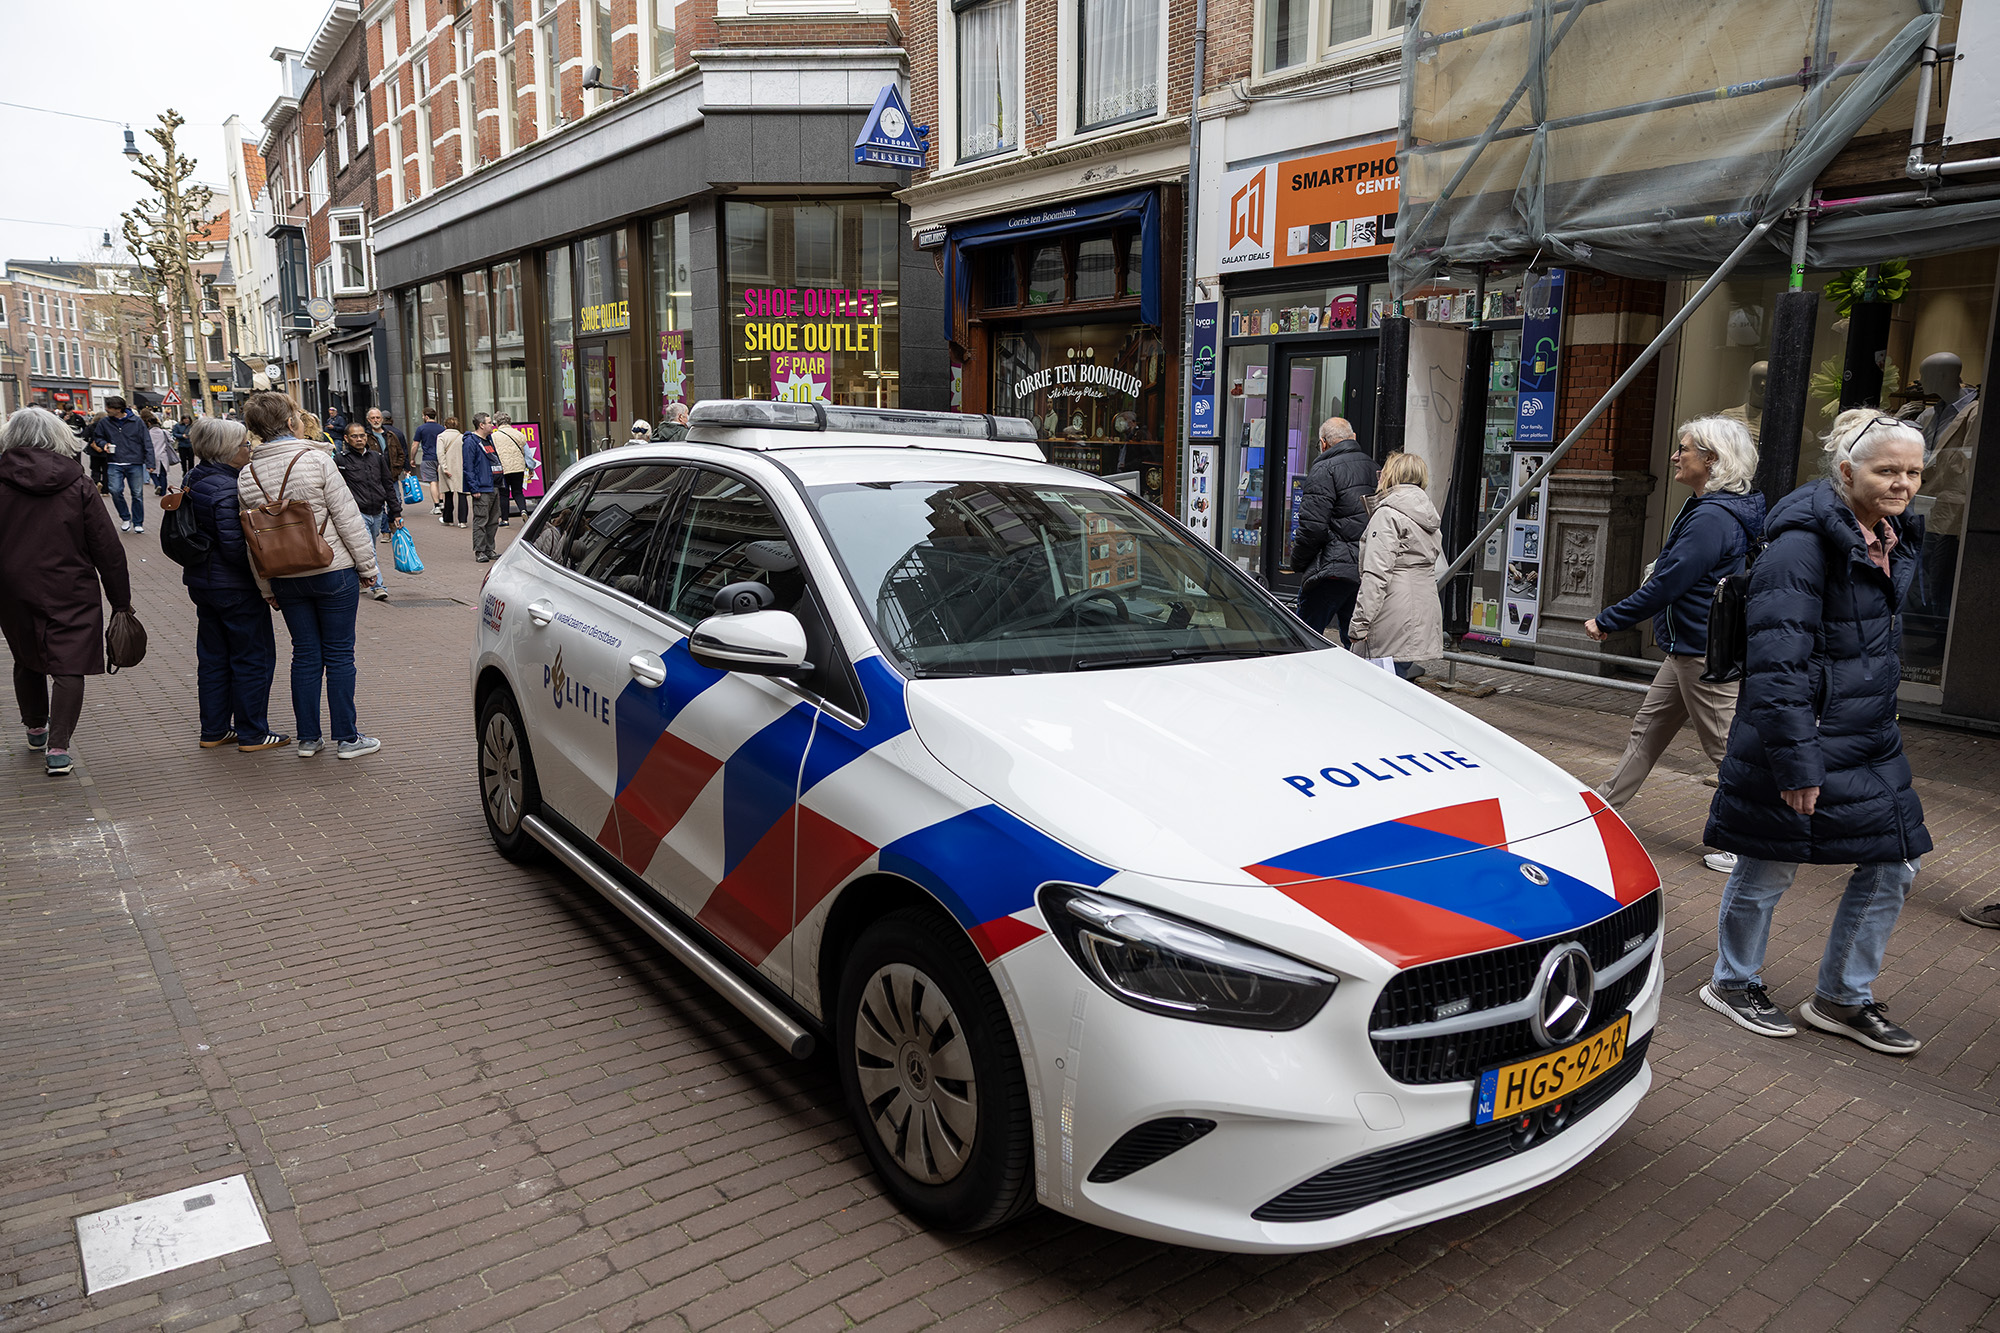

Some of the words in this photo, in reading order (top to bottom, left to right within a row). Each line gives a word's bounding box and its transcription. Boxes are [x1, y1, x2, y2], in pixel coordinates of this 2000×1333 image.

[1729, 80, 1762, 97] AFIX
[891, 139, 911, 147] BOOM
[872, 151, 914, 164] MUSEUM
[1008, 216, 1030, 228] Corrie
[1030, 215, 1041, 224] ten
[1042, 207, 1077, 222] Boomhuis
[1221, 254, 1248, 265] GALAXY
[1248, 251, 1270, 261] DEALS
[744, 288, 798, 317] SHOE
[804, 289, 882, 317] OUTLET
[581, 305, 600, 331] SHOE
[600, 300, 629, 329] OUTLET
[1196, 318, 1211, 328] Lyca
[667, 334, 682, 351] PAAR
[744, 322, 798, 351] SHOE
[804, 323, 882, 351] OUTLET
[792, 357, 825, 375] PAAR
[1014, 367, 1053, 400] CORRIE
[1054, 364, 1077, 384] TEN
[1080, 364, 1142, 398] BOOMHUIS
[1047, 387, 1062, 399] The
[1061, 386, 1083, 402] Hiding
[1083, 386, 1104, 399] Place
[493, 599, 505, 621] 112
[544, 664, 610, 726] POLITIE
[1282, 750, 1481, 798] POLITIE
[1504, 1025, 1623, 1110] HGS-92-R
[1479, 1102, 1492, 1115] NL
